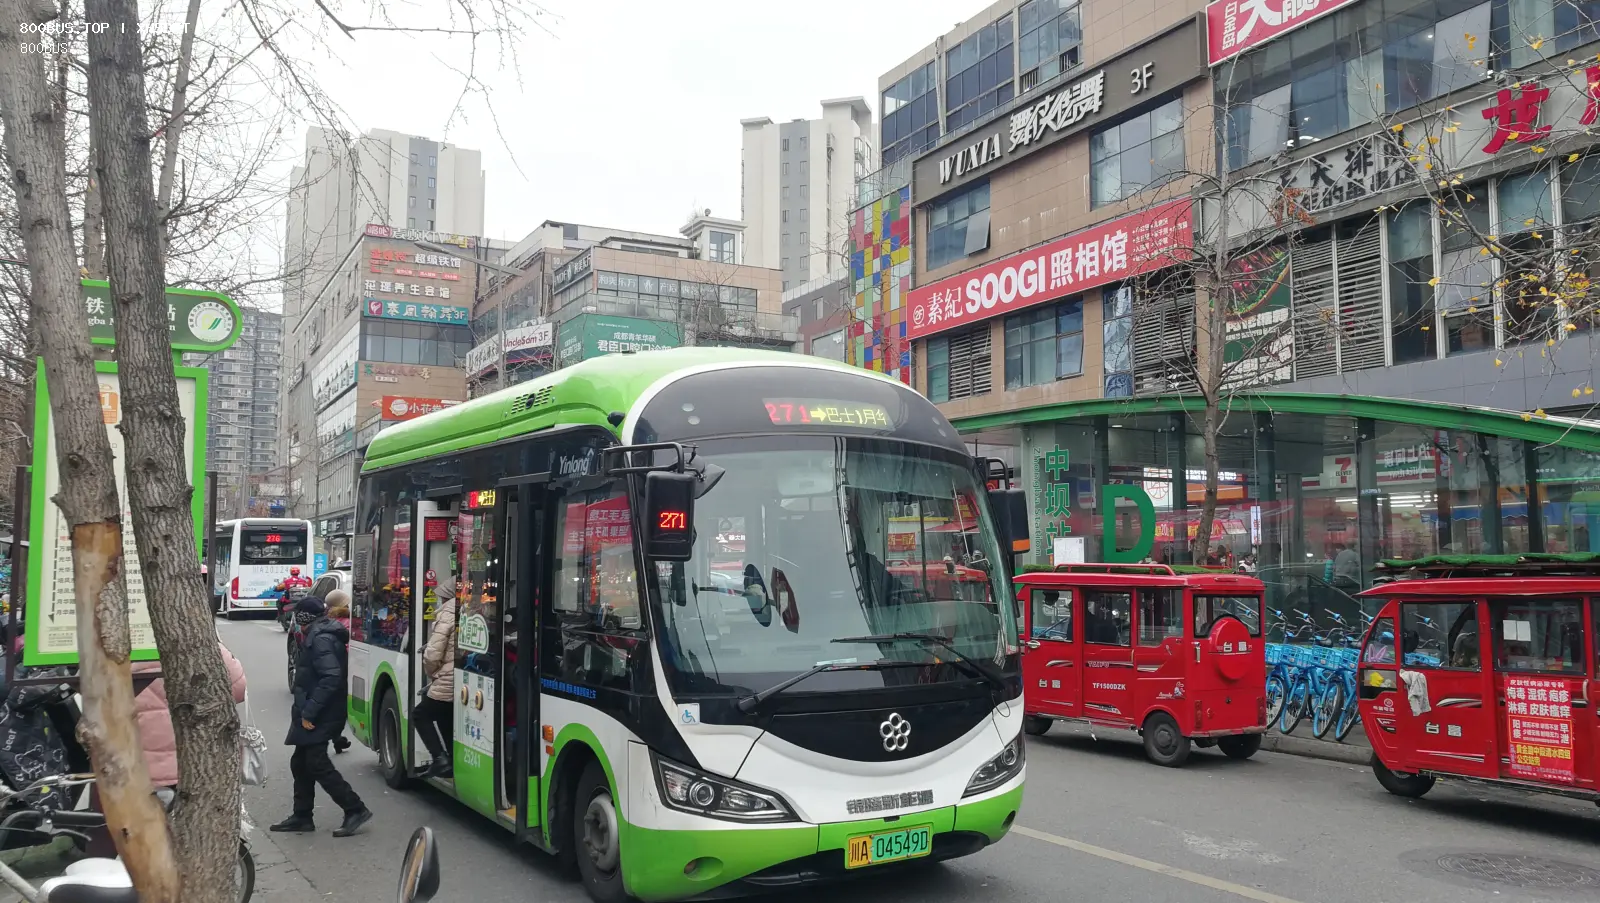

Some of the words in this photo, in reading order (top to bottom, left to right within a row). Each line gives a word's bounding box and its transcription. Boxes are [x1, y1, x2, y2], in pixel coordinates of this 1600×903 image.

[939, 133, 1002, 184] WUXIA
[1130, 62, 1155, 94] 3F
[965, 257, 1046, 313] SOOGI
[1050, 229, 1128, 290] 照相馆
[454, 310, 465, 320] 3F
[538, 331, 549, 342] 3F
[765, 403, 811, 423] 271
[559, 456, 589, 475] Yinlong
[1033, 448, 1042, 506] Zhongba
[1335, 457, 1352, 484] 7
[1045, 444, 1071, 555] 中坝站
[660, 512, 685, 529] 271
[1034, 509, 1042, 556] Station
[1102, 484, 1156, 563] D
[266, 535, 281, 543] 276
[2, 728, 17, 750] bear
[851, 841, 868, 862] 川A
[876, 830, 928, 858] 04549D
